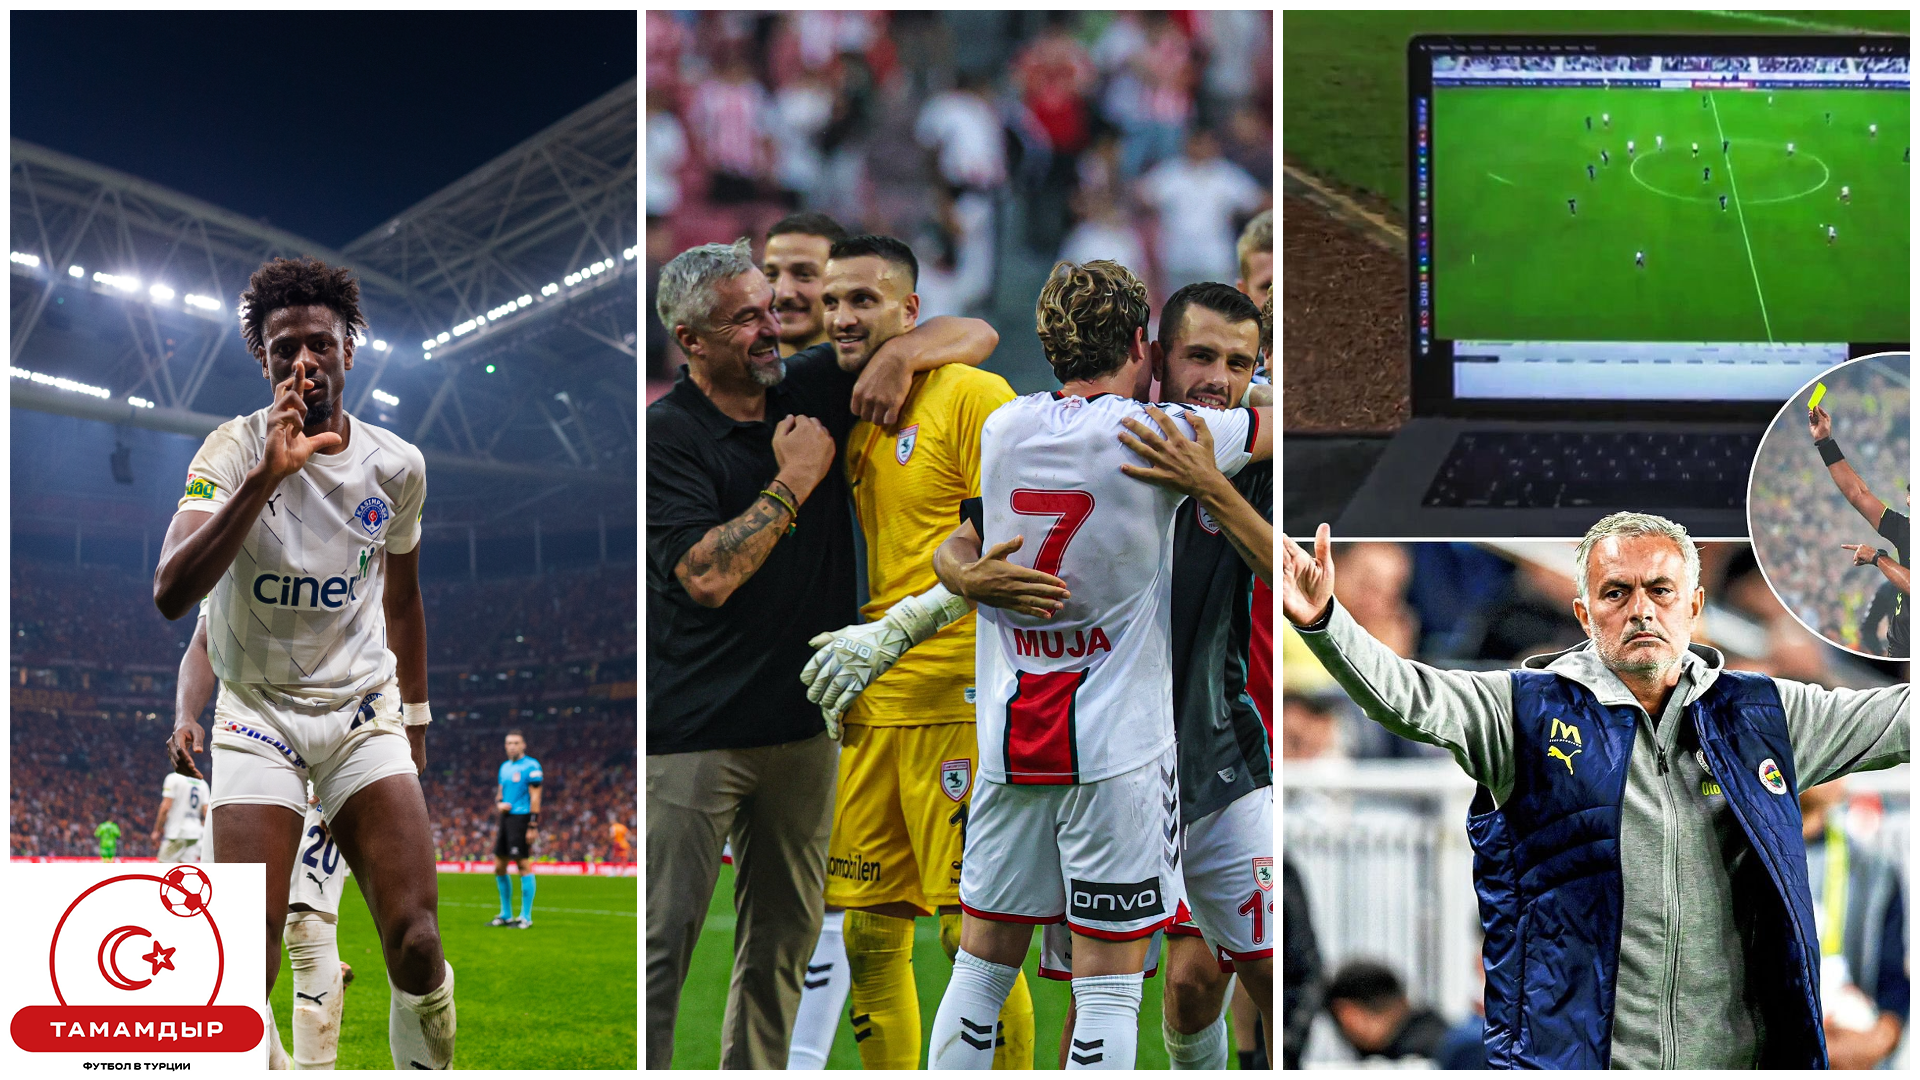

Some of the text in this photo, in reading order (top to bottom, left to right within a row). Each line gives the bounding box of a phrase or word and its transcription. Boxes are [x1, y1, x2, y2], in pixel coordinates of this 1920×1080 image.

[1010, 488, 1095, 618] 7
[1013, 628, 1112, 659] MUJA
[190, 786, 199, 809] 6
[302, 825, 340, 875] 20
[1238, 889, 1273, 945] 1
